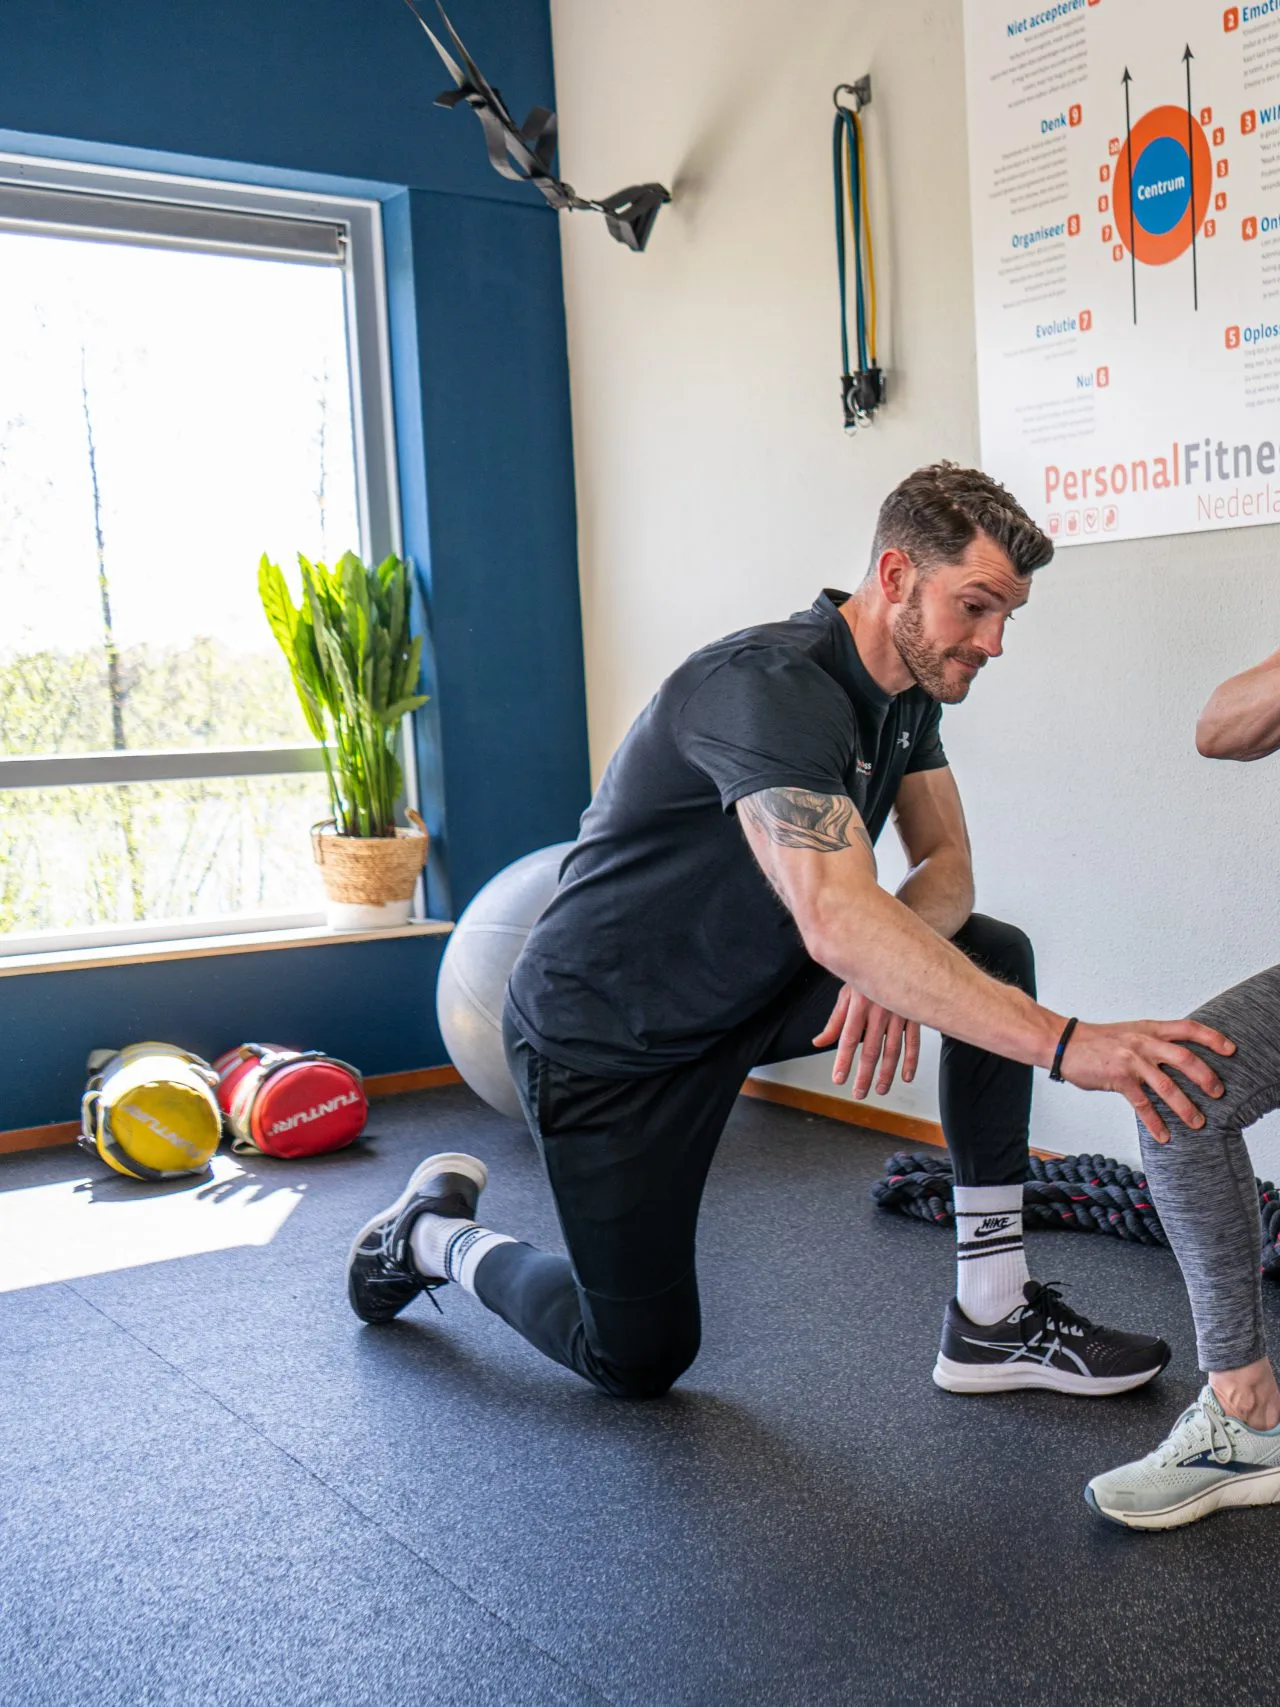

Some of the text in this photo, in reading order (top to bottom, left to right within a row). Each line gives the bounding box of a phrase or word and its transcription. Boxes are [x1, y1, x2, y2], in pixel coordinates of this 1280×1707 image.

[1007, 0, 1085, 36] Niet accepteren
[1041, 113, 1067, 134] Denk
[1137, 176, 1185, 201] Centrum
[1012, 222, 1065, 249] Organiseer
[1036, 316, 1077, 338] Evolutie
[1076, 373, 1094, 388] Nul
[270, 1090, 360, 1136] TUNTURI
[982, 1217, 1009, 1229] NIKE
